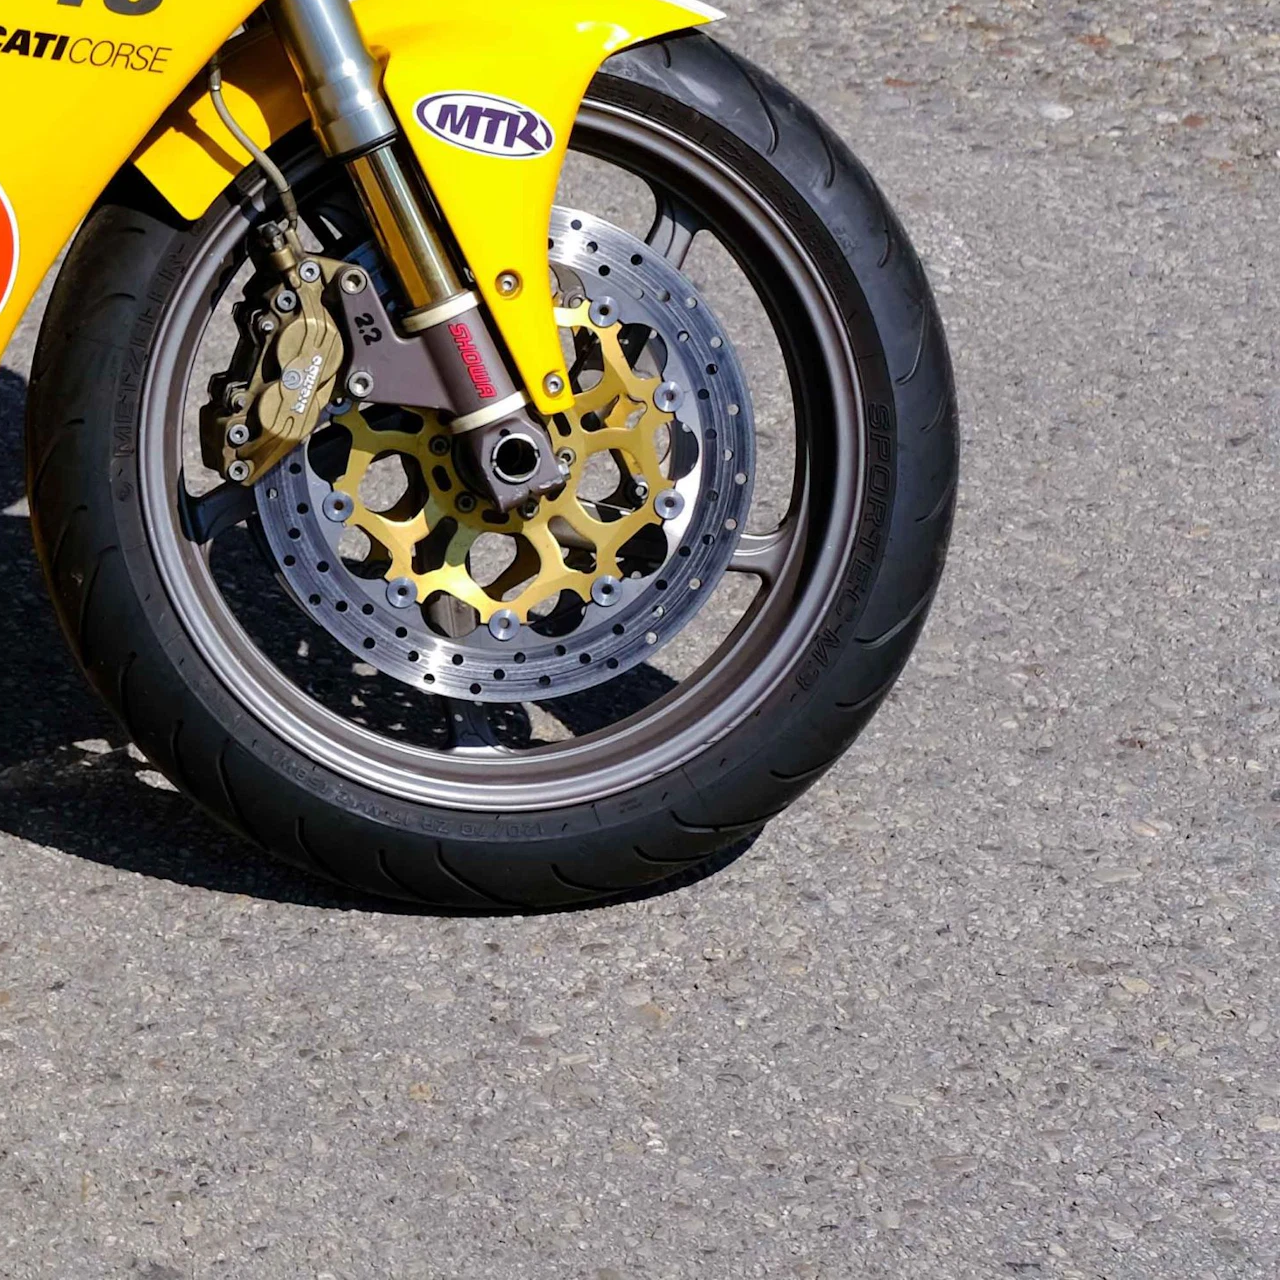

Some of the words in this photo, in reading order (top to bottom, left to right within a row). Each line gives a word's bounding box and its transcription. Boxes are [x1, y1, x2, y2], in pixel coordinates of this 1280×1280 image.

[436, 104, 546, 151] MTR
[354, 312, 382, 346] 2.2
[292, 354, 322, 414] brembo
[448, 322, 498, 400] SHOWA
